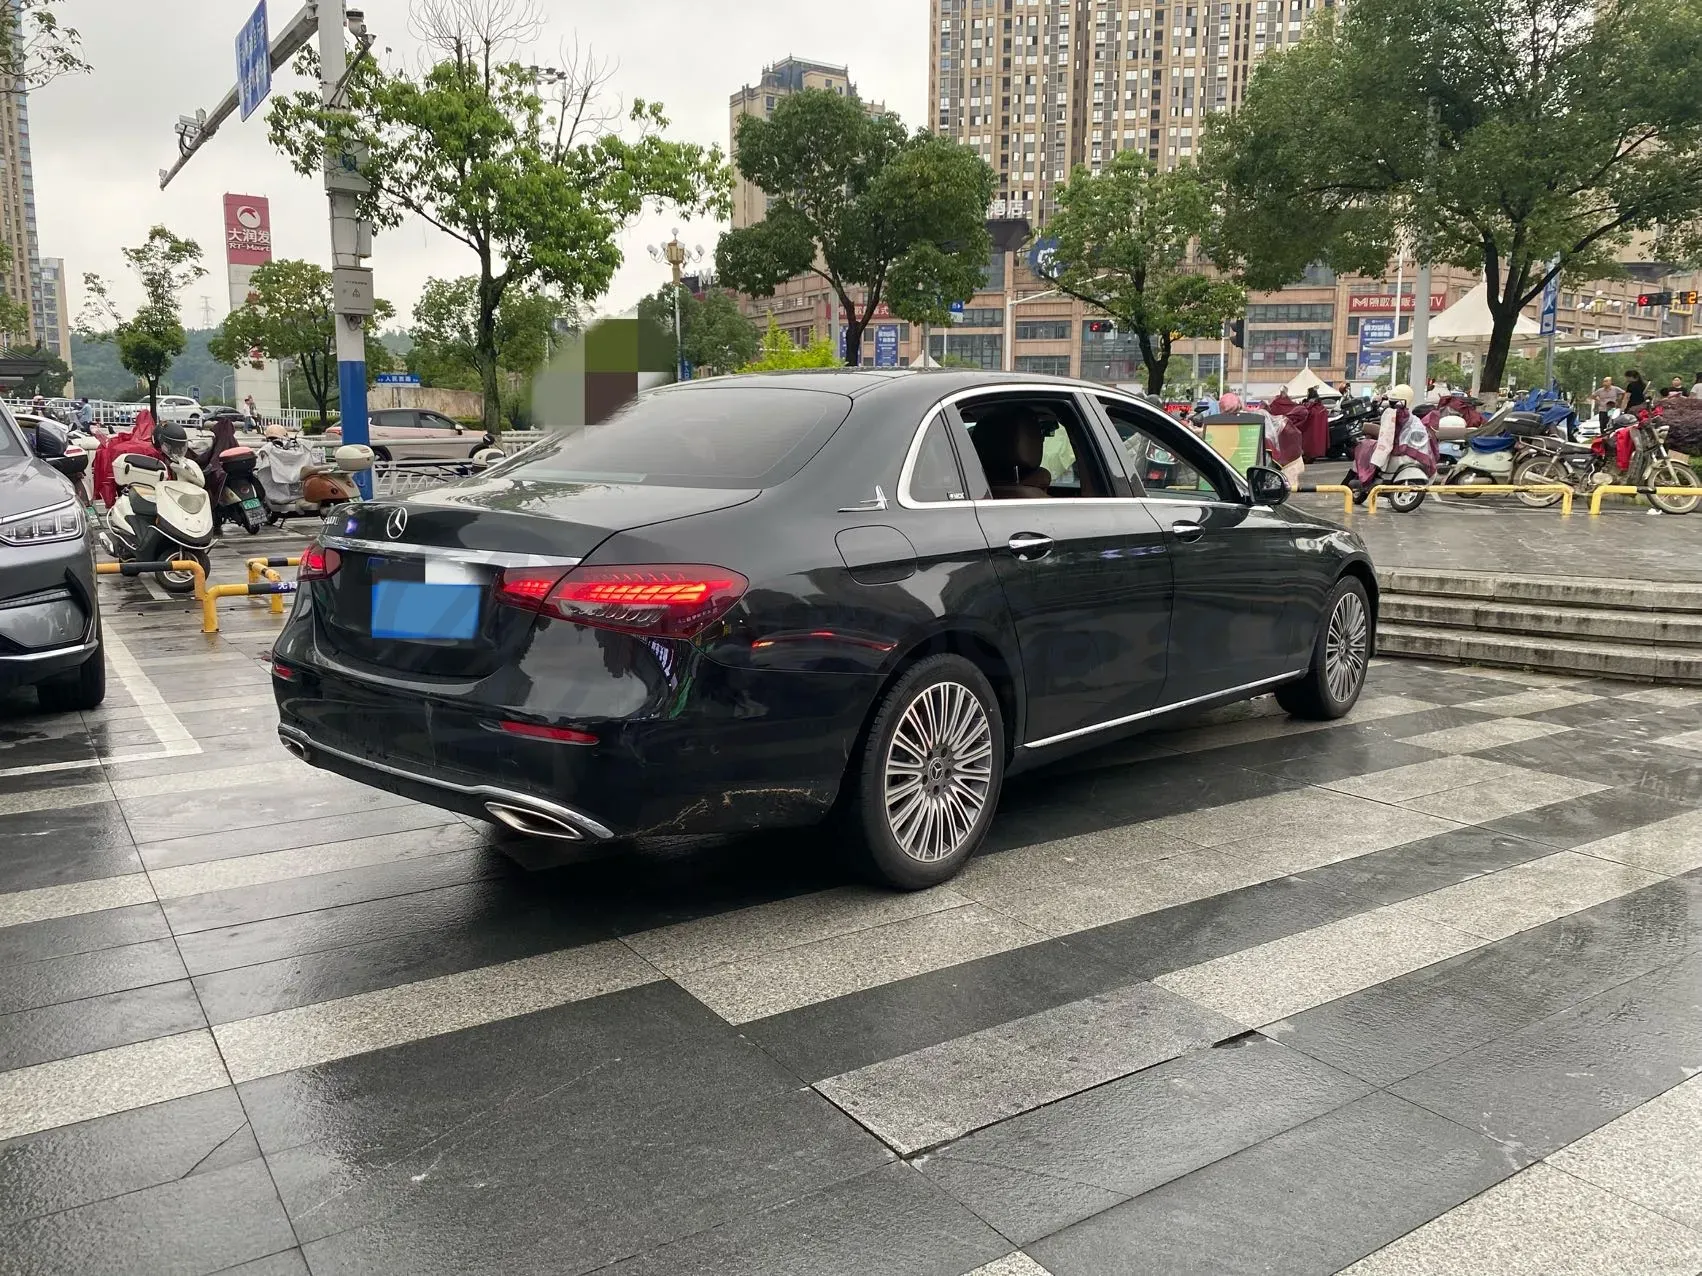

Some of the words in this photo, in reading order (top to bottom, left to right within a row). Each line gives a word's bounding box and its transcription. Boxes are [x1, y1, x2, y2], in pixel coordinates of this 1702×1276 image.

[228, 228, 271, 244] 大润发
[228, 241, 271, 252] RT-Mart
